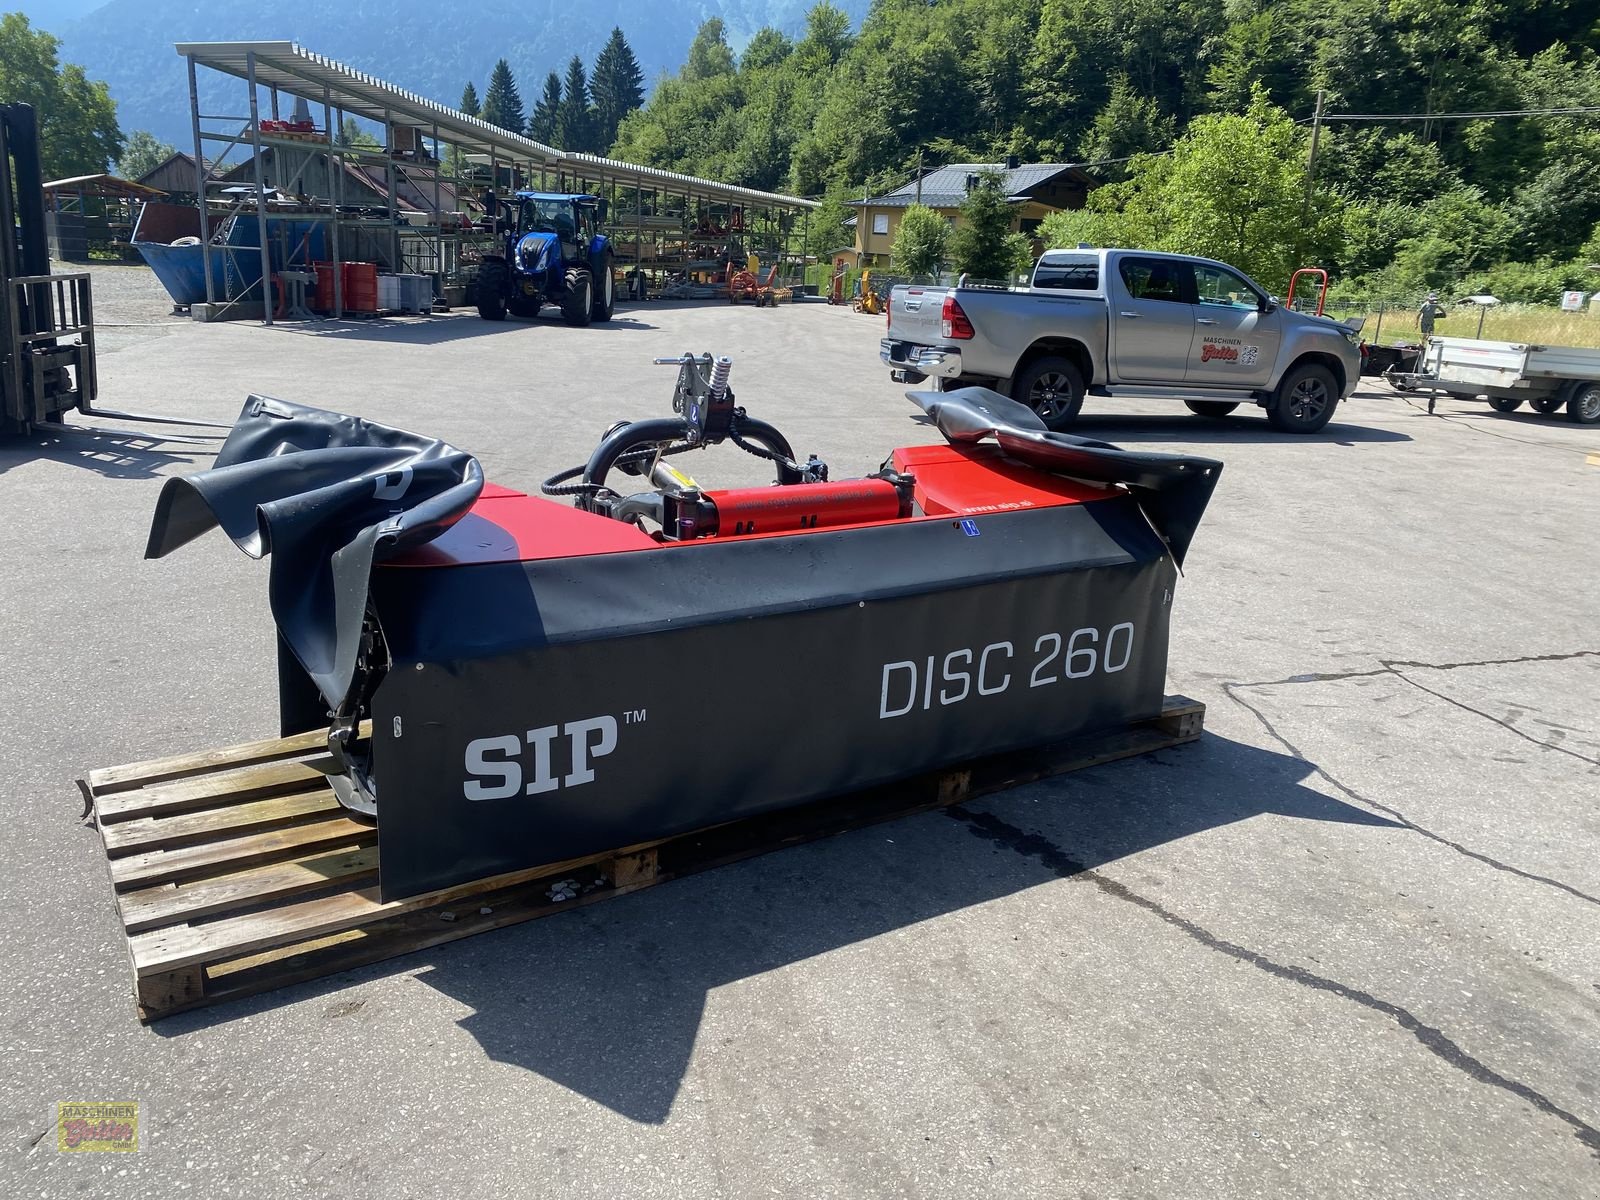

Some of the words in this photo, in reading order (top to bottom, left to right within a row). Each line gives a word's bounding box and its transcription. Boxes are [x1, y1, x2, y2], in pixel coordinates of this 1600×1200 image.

[1203, 336, 1242, 346] MASCHINEN
[879, 641, 1014, 719] DISC
[1029, 622, 1135, 689] 260
[463, 715, 618, 801] SIP
